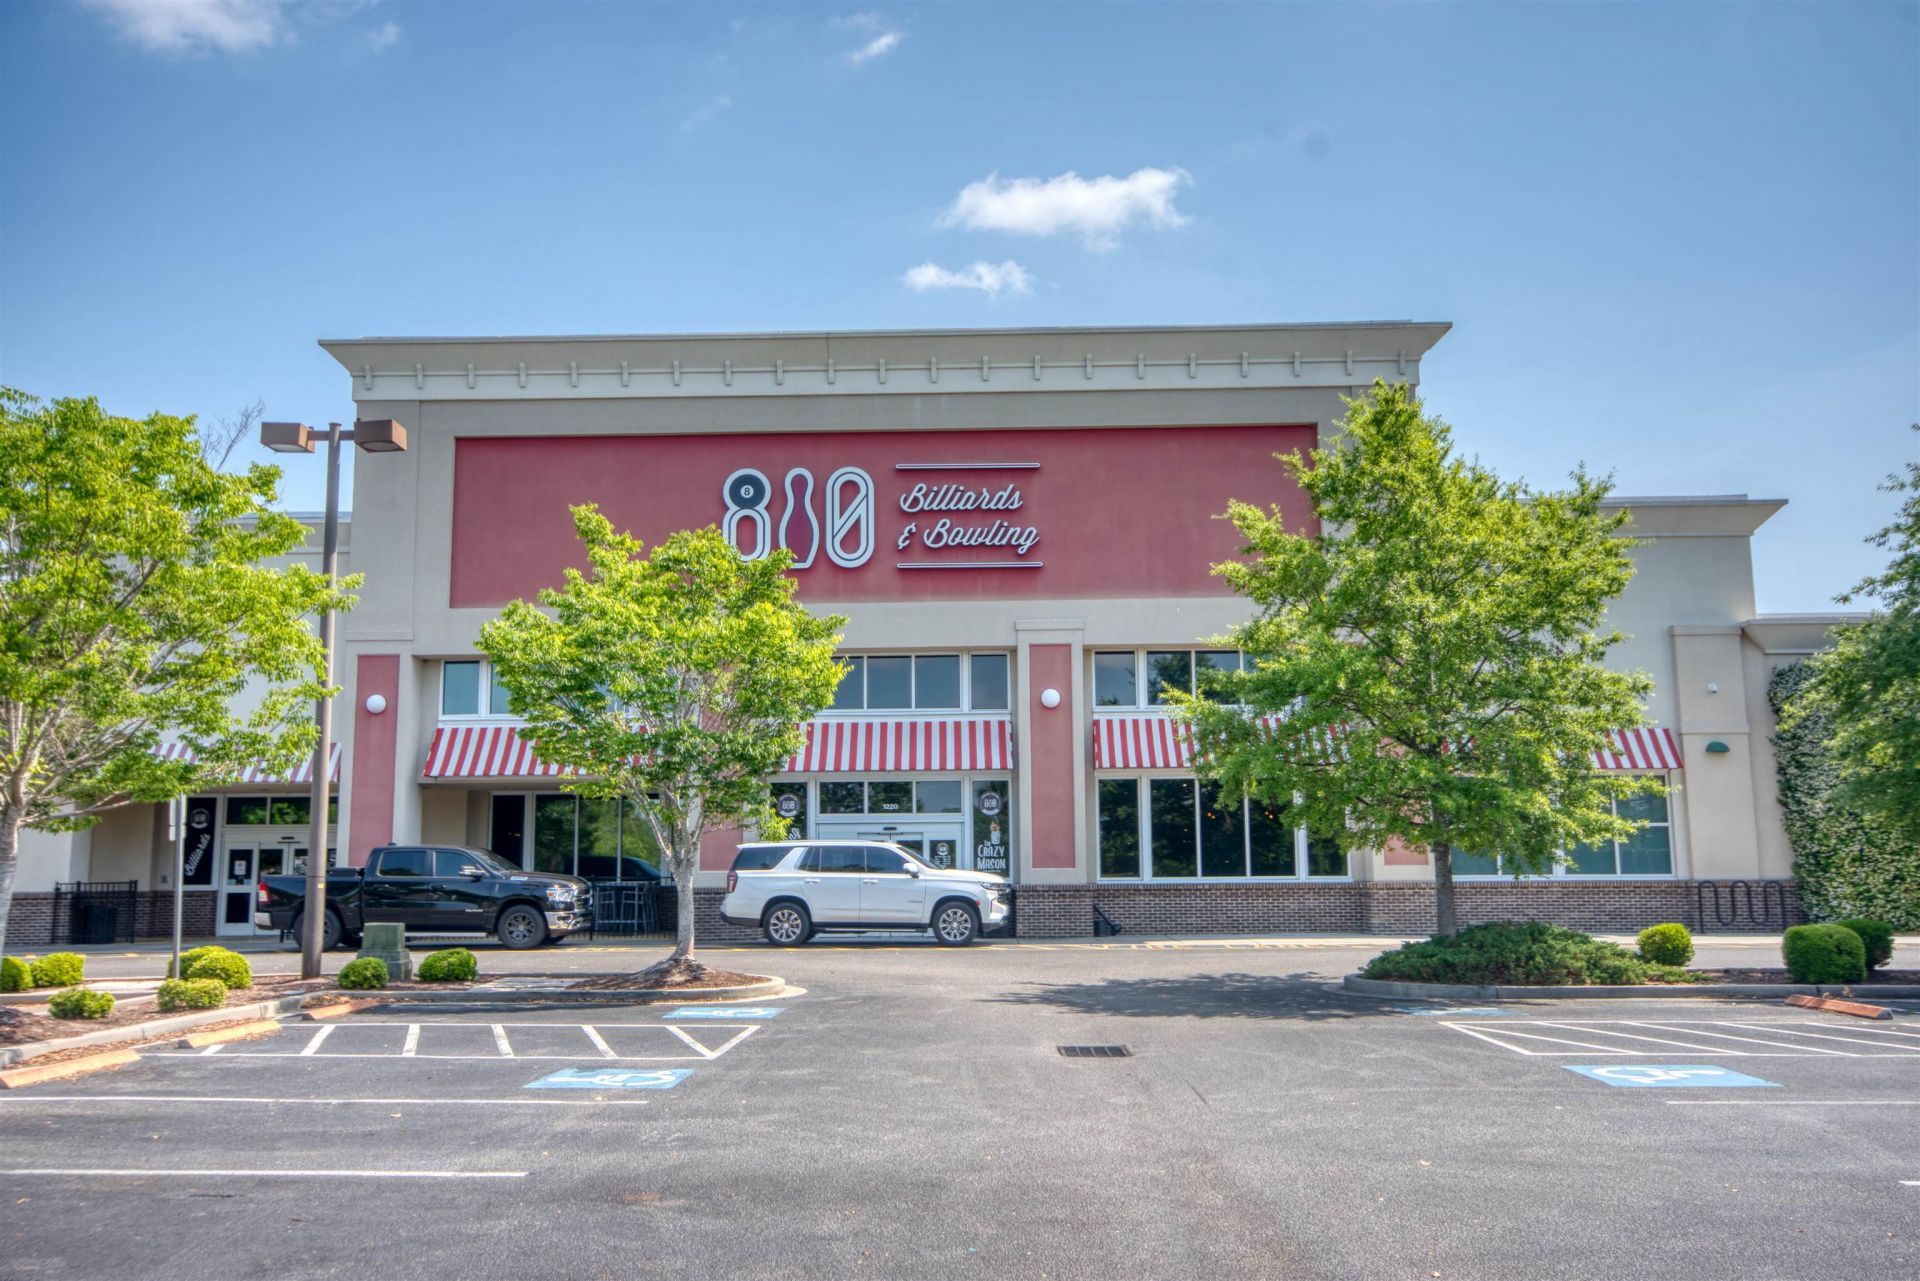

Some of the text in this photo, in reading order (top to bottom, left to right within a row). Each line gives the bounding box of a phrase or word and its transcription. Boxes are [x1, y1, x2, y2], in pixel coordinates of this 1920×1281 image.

[900, 483, 1023, 513] Billiards
[898, 518, 1040, 555] & Bowling
[184, 833, 211, 876] Billiards
